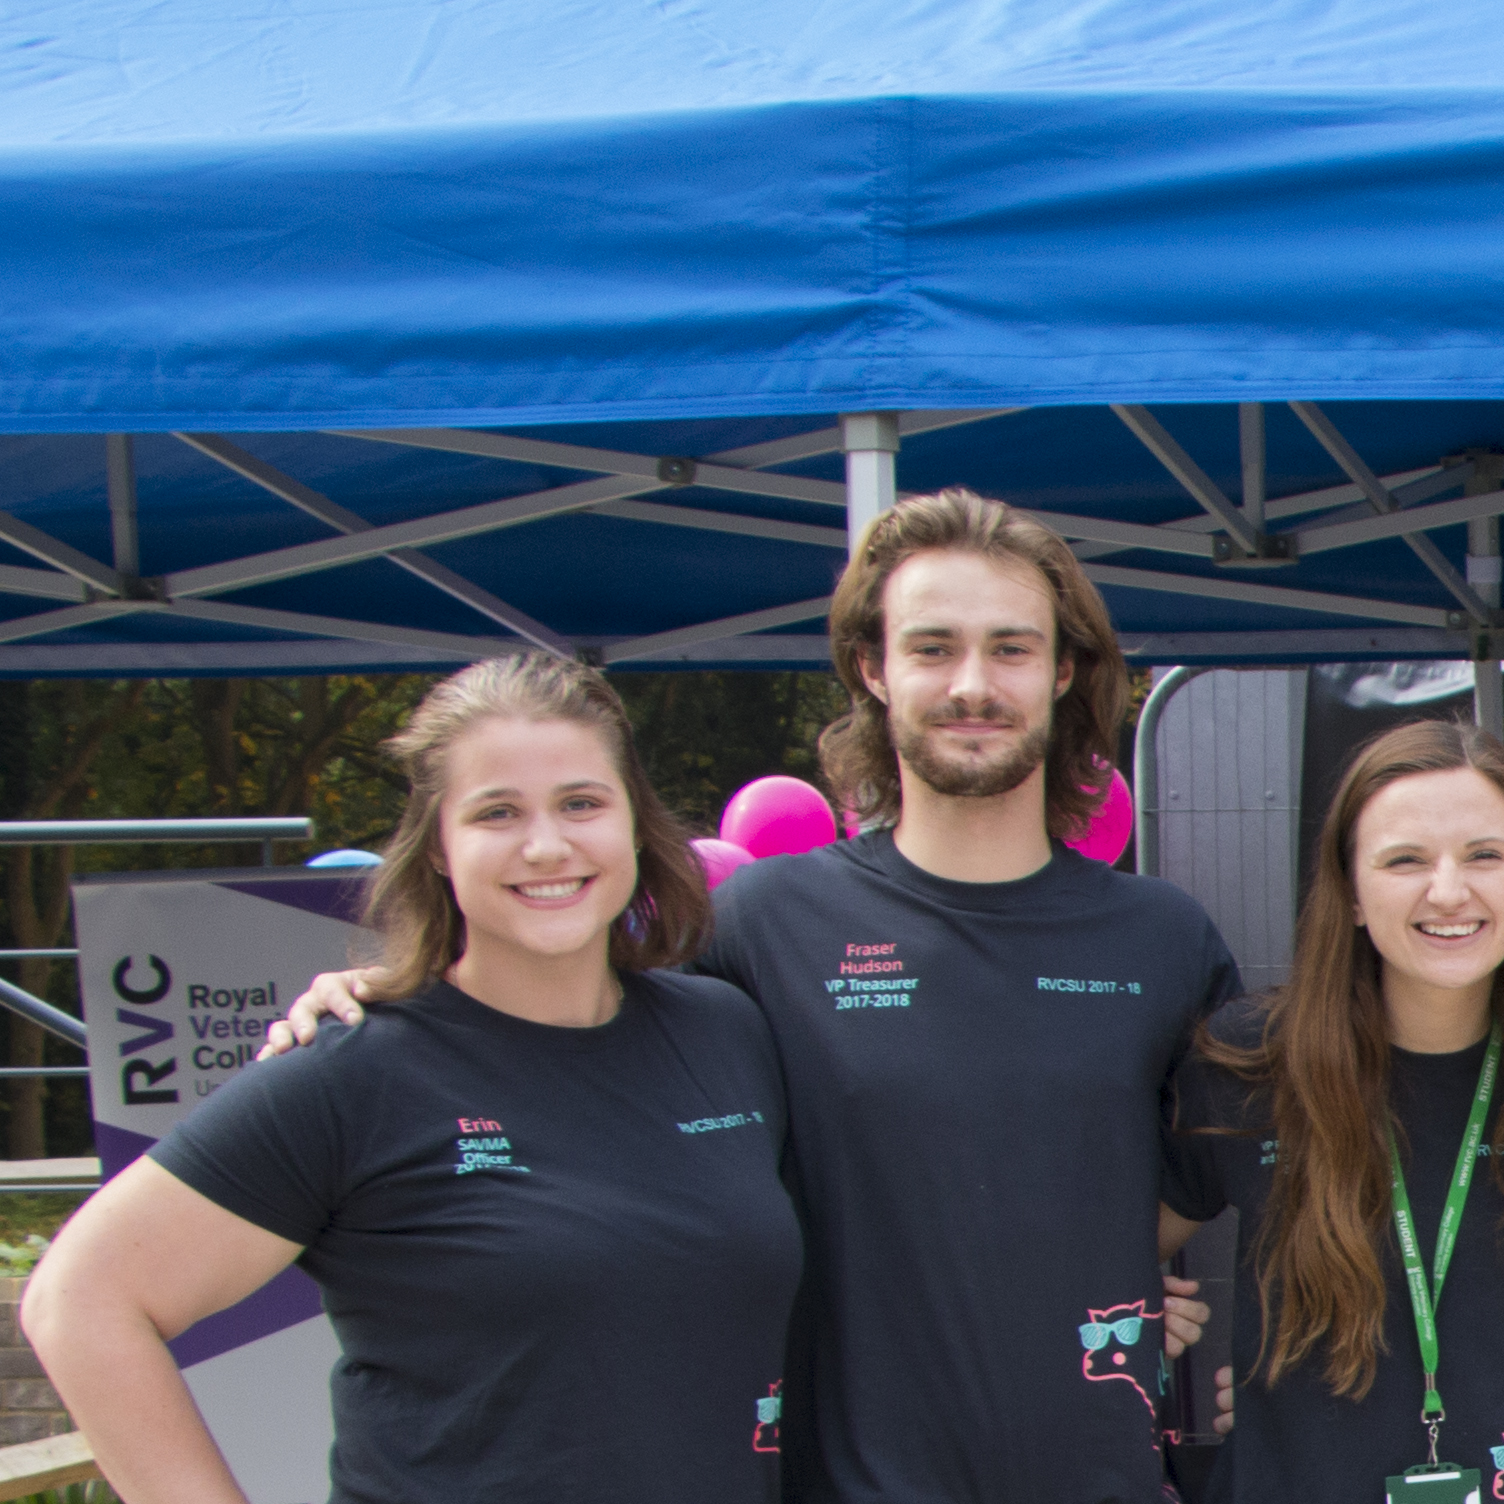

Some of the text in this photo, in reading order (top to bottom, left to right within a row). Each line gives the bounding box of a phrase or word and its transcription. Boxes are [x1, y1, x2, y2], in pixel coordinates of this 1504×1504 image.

[845, 943, 898, 957] Fraser
[840, 959, 903, 974] Hudson
[824, 978, 919, 993] VP Treasurer
[1036, 976, 1086, 992] RVCSU
[1087, 980, 1118, 993] 2017
[1126, 982, 1142, 994] 18
[187, 981, 278, 1013] Royal
[835, 993, 911, 1010] 2017-2018
[111, 953, 180, 1106] RVC
[1477, 1055, 1497, 1101] STUDENT
[457, 1118, 503, 1133] Erin
[1395, 1209, 1416, 1259] STUDENT
